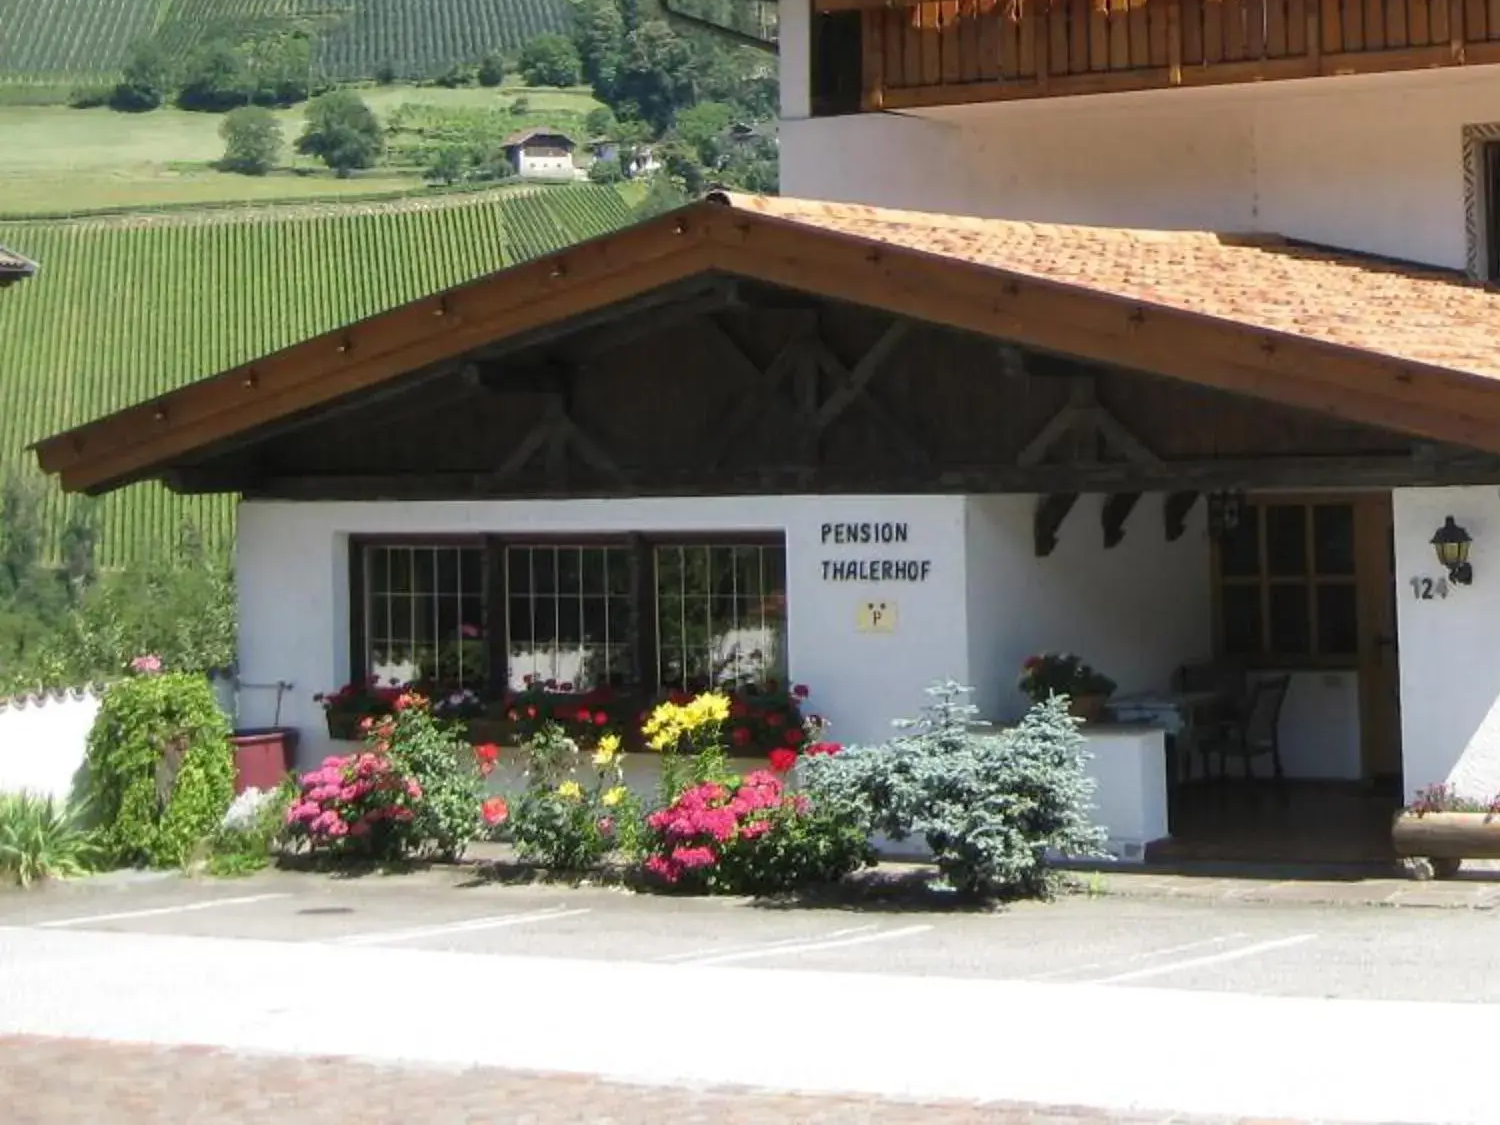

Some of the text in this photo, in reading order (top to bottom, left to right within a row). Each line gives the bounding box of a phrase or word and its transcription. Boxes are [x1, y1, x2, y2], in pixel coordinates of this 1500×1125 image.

[821, 523, 908, 543] PENSION
[821, 560, 932, 581] THALERHOF
[1409, 576, 1449, 600] 124
